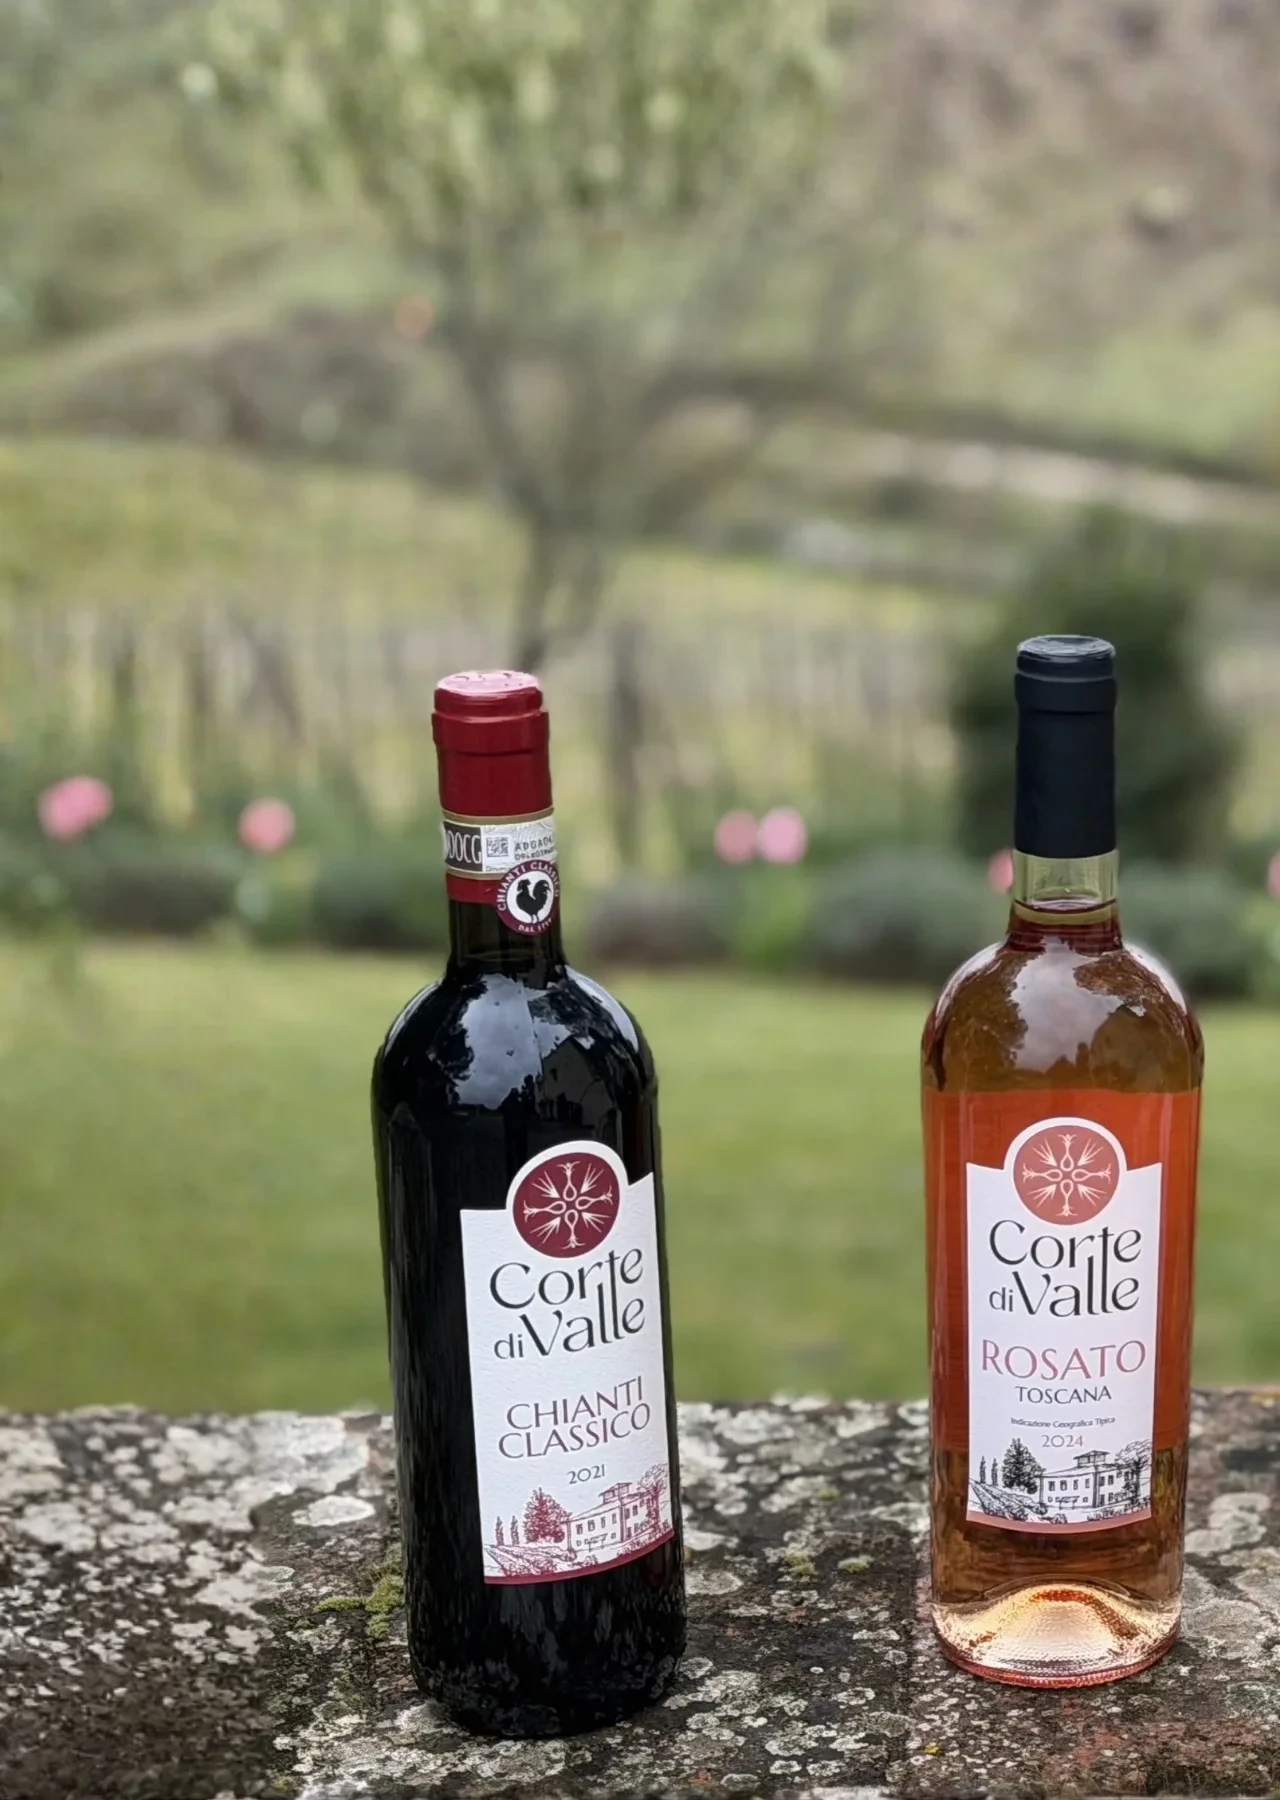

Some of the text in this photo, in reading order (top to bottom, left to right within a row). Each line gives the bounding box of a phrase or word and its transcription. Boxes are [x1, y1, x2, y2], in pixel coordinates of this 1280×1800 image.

[497, 865, 526, 911] CHIANTI
[989, 1219, 1142, 1269] Corte
[489, 1248, 644, 1309] Corte
[989, 1255, 1140, 1318] di Valle
[493, 1281, 646, 1360] di Valle
[982, 1339, 1146, 1381] ROSATO
[506, 1375, 643, 1430] CHIANTI
[1014, 1385, 1112, 1405] TOSCANA
[498, 1402, 651, 1459] CLASSICO
[1010, 1416, 1116, 1431] Indicazione Geografica Tipica
[1041, 1434, 1084, 1448] 2024
[567, 1463, 606, 1485] 2021
